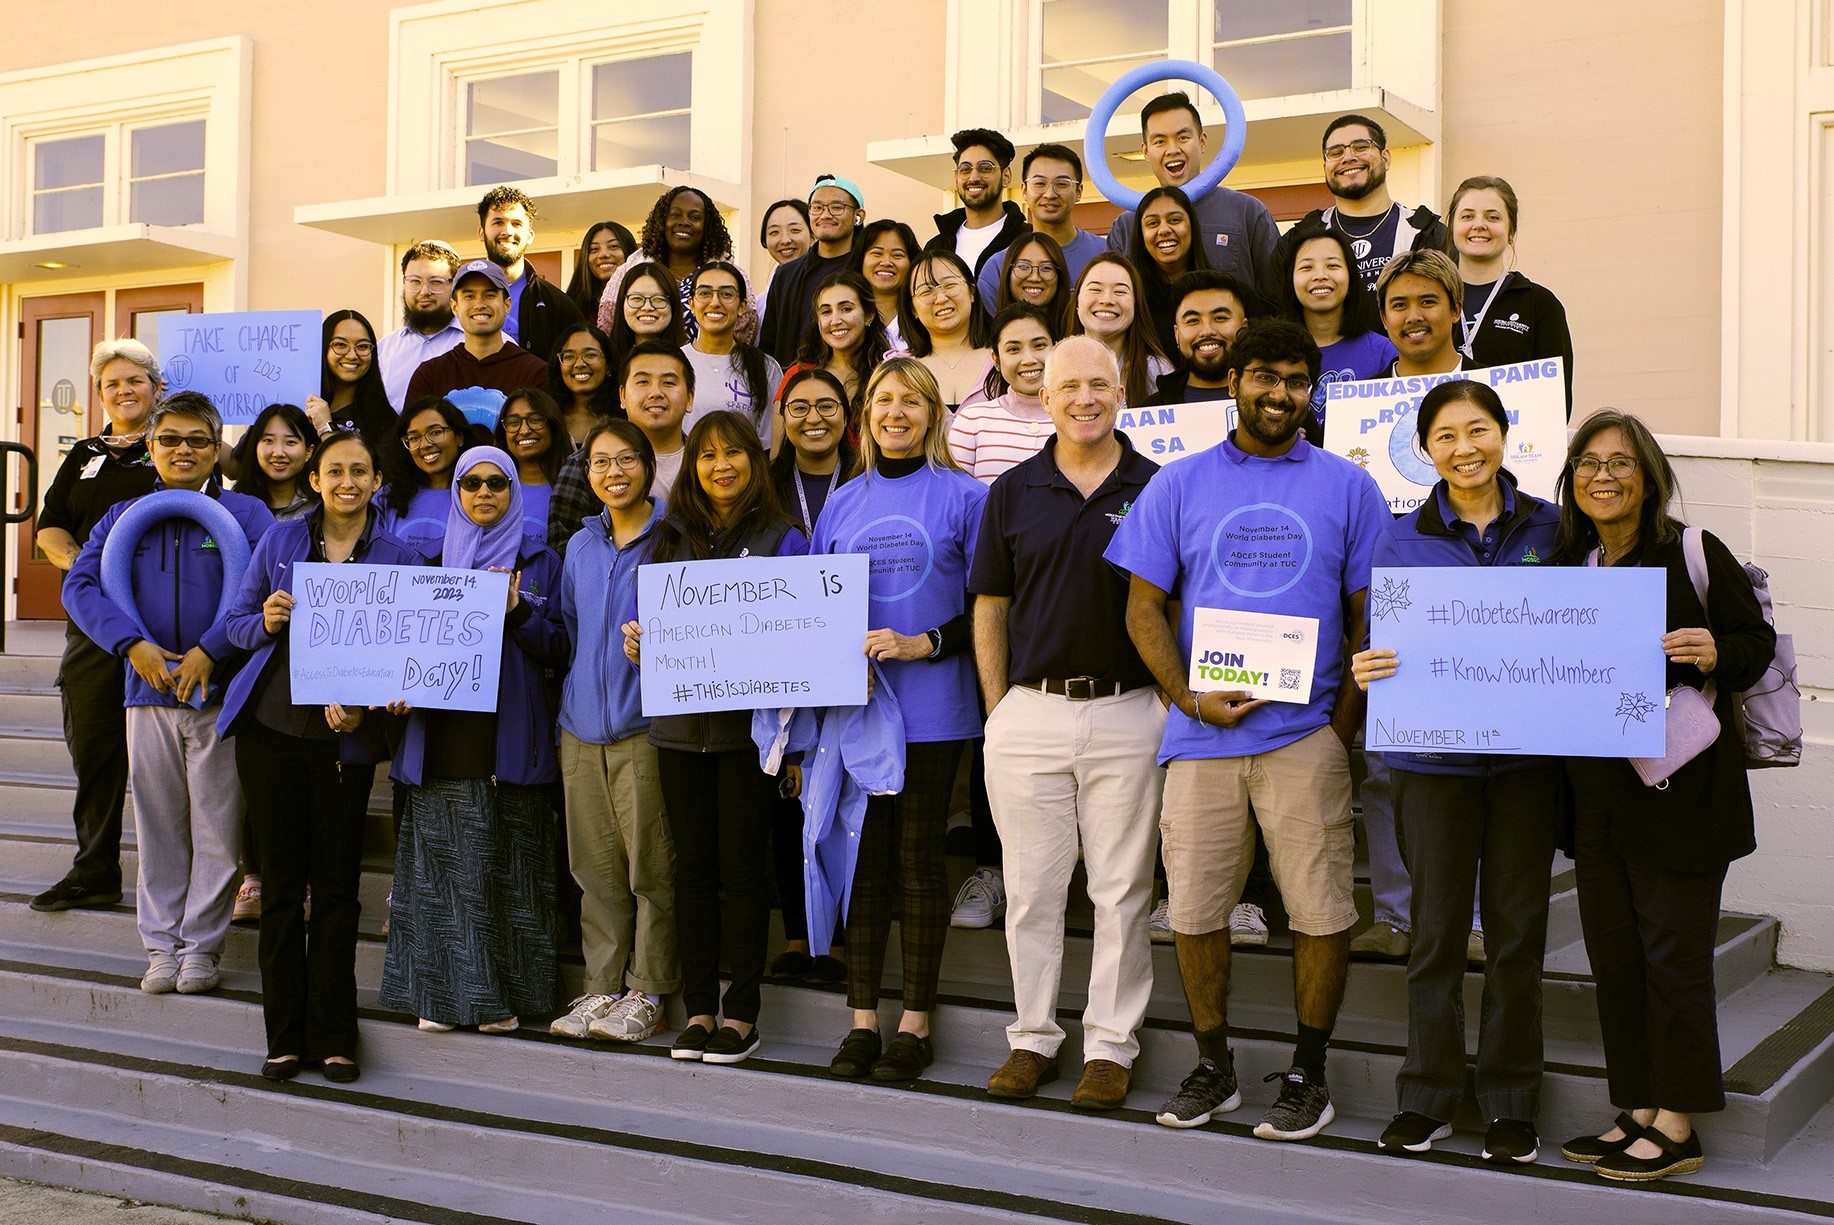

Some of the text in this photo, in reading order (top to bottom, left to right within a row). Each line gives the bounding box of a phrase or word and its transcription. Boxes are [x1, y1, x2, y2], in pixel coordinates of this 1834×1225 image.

[176, 324, 301, 354] TAKE CHARGE
[225, 365, 240, 384] OF
[253, 358, 282, 382] 2023
[1489, 361, 1558, 387] PANG
[208, 393, 280, 417] MORRO
[1113, 408, 1175, 429] AAN
[1150, 436, 1186, 455] SA
[868, 533, 903, 542] November
[1225, 533, 1249, 541] World
[1239, 525, 1278, 533] November
[879, 541, 909, 549] Diabetes
[910, 540, 924, 548] Day
[888, 557, 915, 565] Student
[1224, 560, 1267, 568] Community
[1230, 551, 1291, 560] ADCES Student
[305, 570, 399, 608] World
[411, 574, 463, 586] November
[660, 566, 797, 610] NOVEMBER
[432, 587, 464, 602] 2023
[1426, 597, 1599, 626] #DiabetesAwareness
[309, 608, 490, 648] DIABETES
[648, 612, 827, 645] AMERICAN DIABETES
[655, 648, 716, 673] MONTH!
[1198, 650, 1244, 668] JOIN
[402, 654, 483, 701] Day!
[1197, 665, 1269, 686] TODAY!
[1430, 655, 1616, 685] #KnowYourNumbers
[1374, 717, 1466, 746] NOVEMBER
